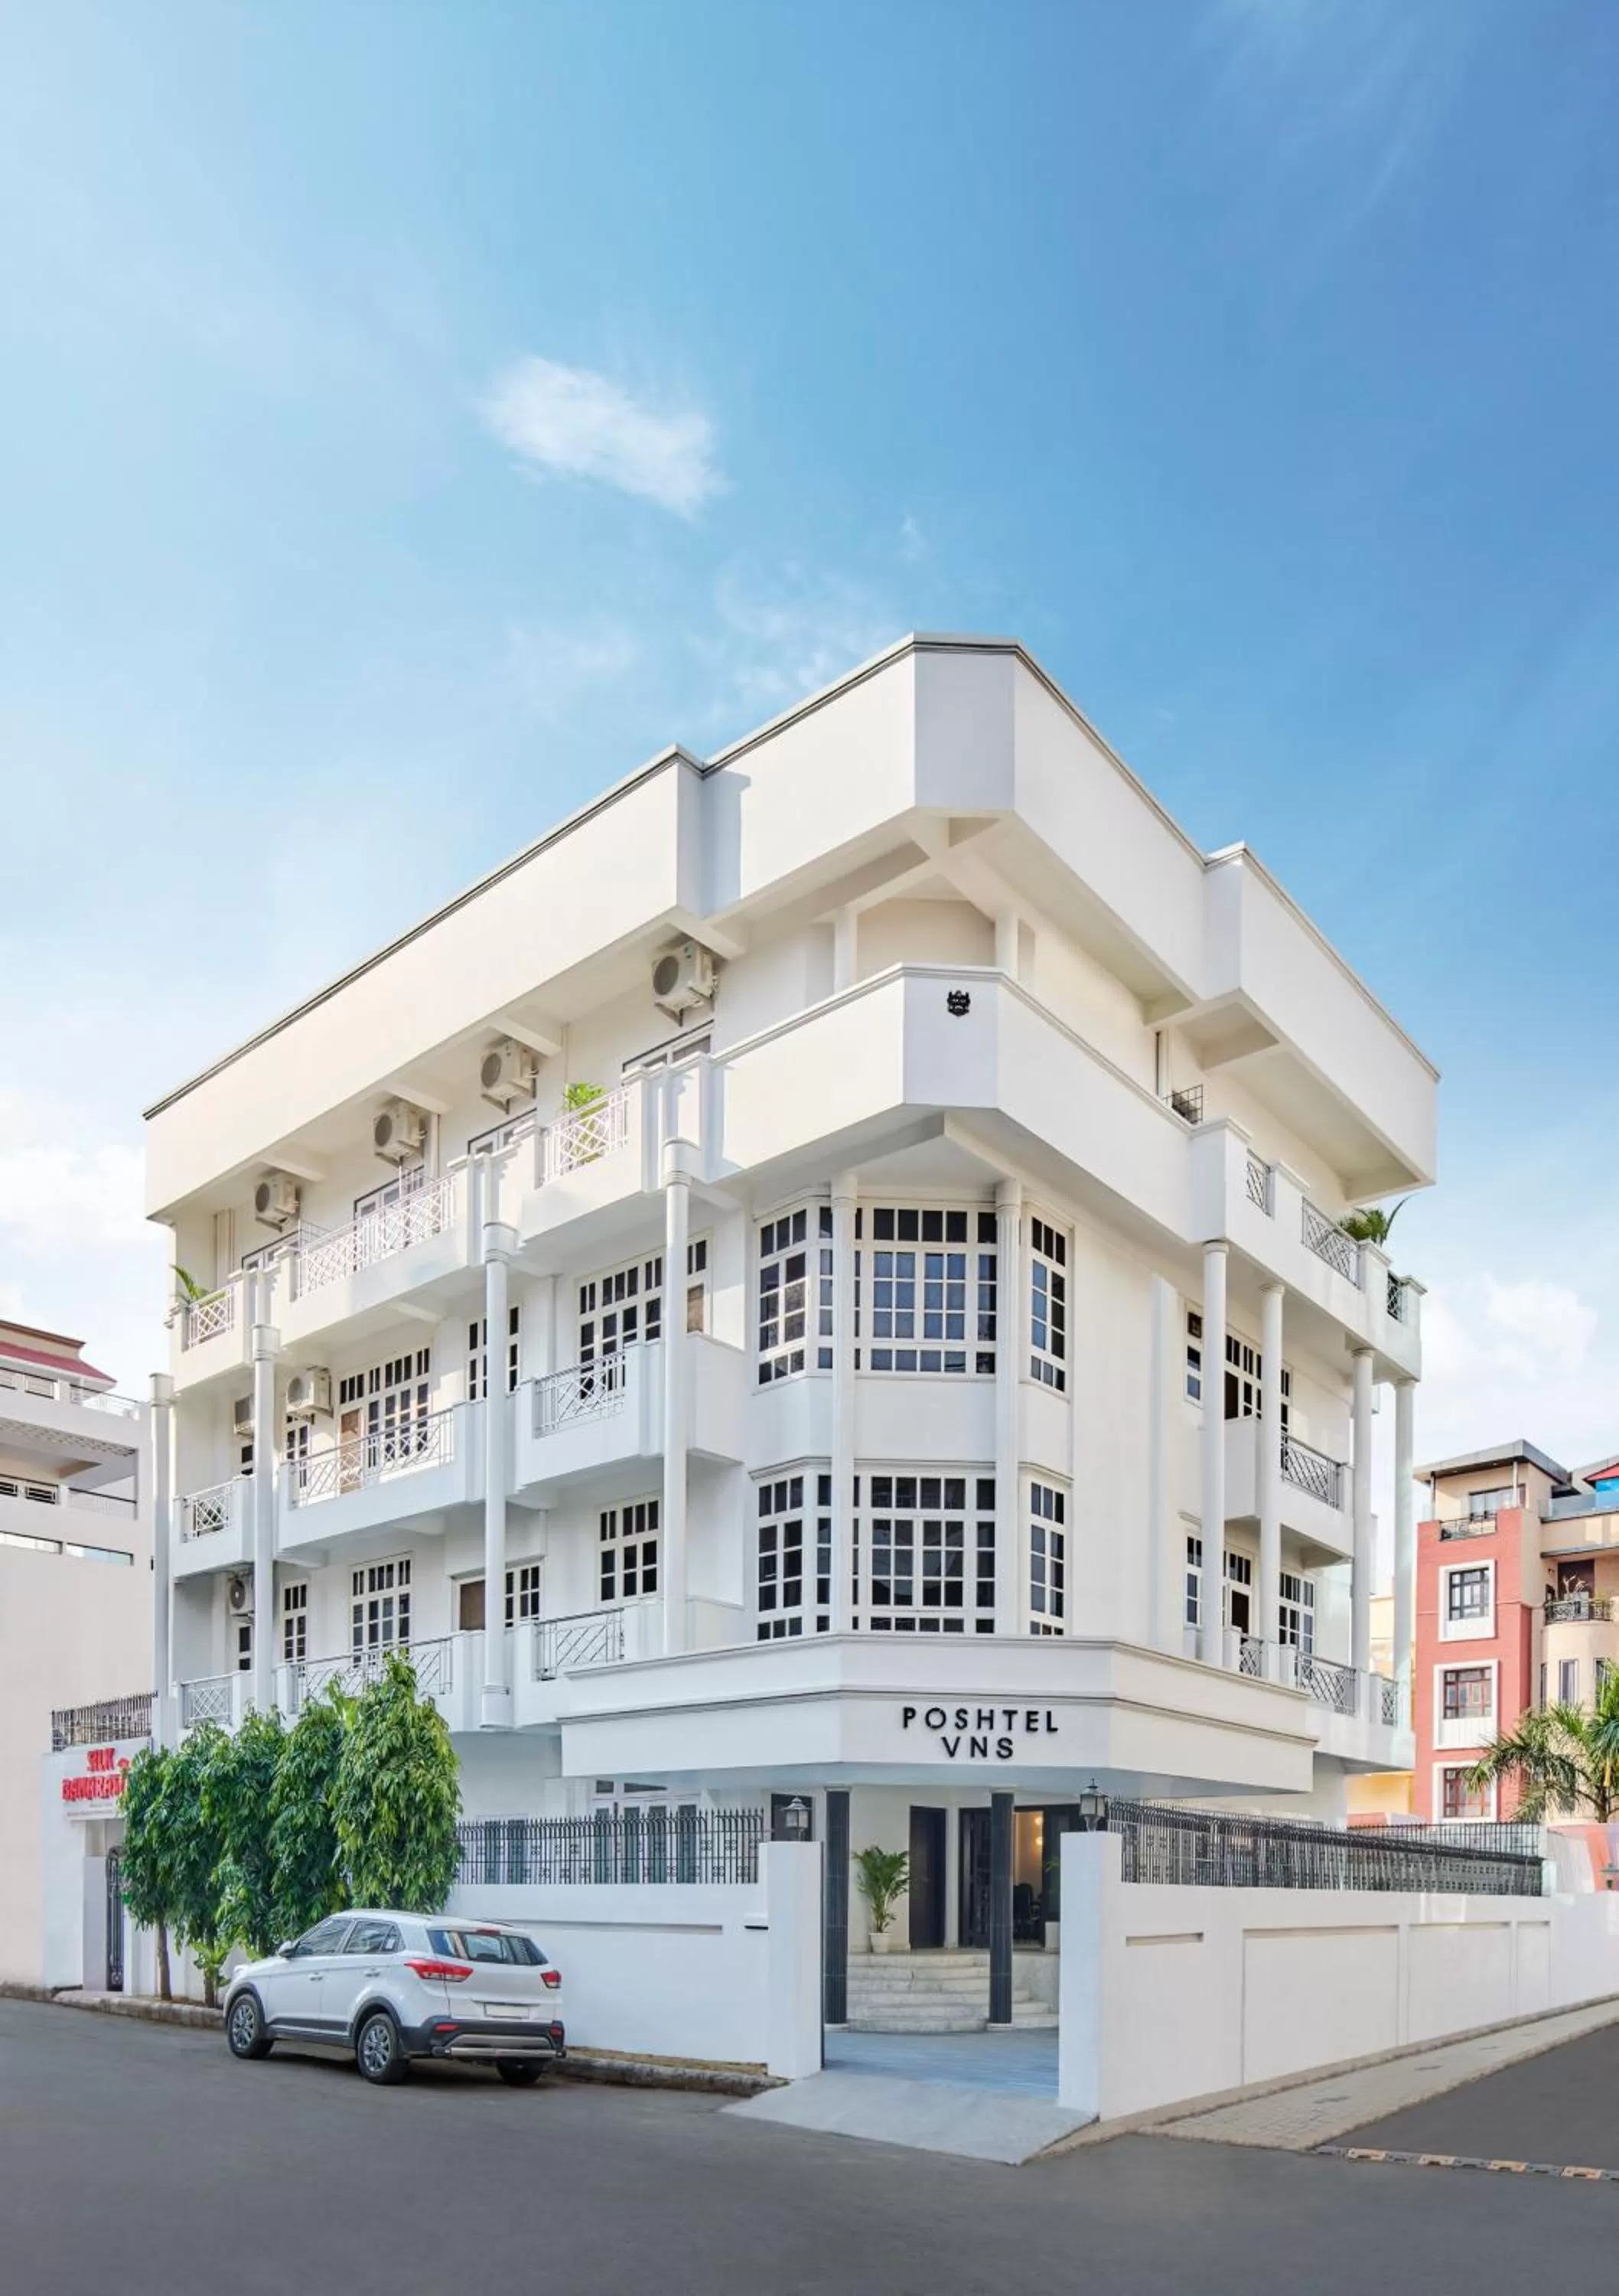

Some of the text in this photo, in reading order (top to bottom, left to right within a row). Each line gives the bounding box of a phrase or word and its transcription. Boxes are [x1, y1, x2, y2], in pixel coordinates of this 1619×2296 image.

[903, 1707, 1059, 1732] POSHTEL
[86, 1748, 116, 1772] SILK
[941, 1737, 1014, 1759] VNS
